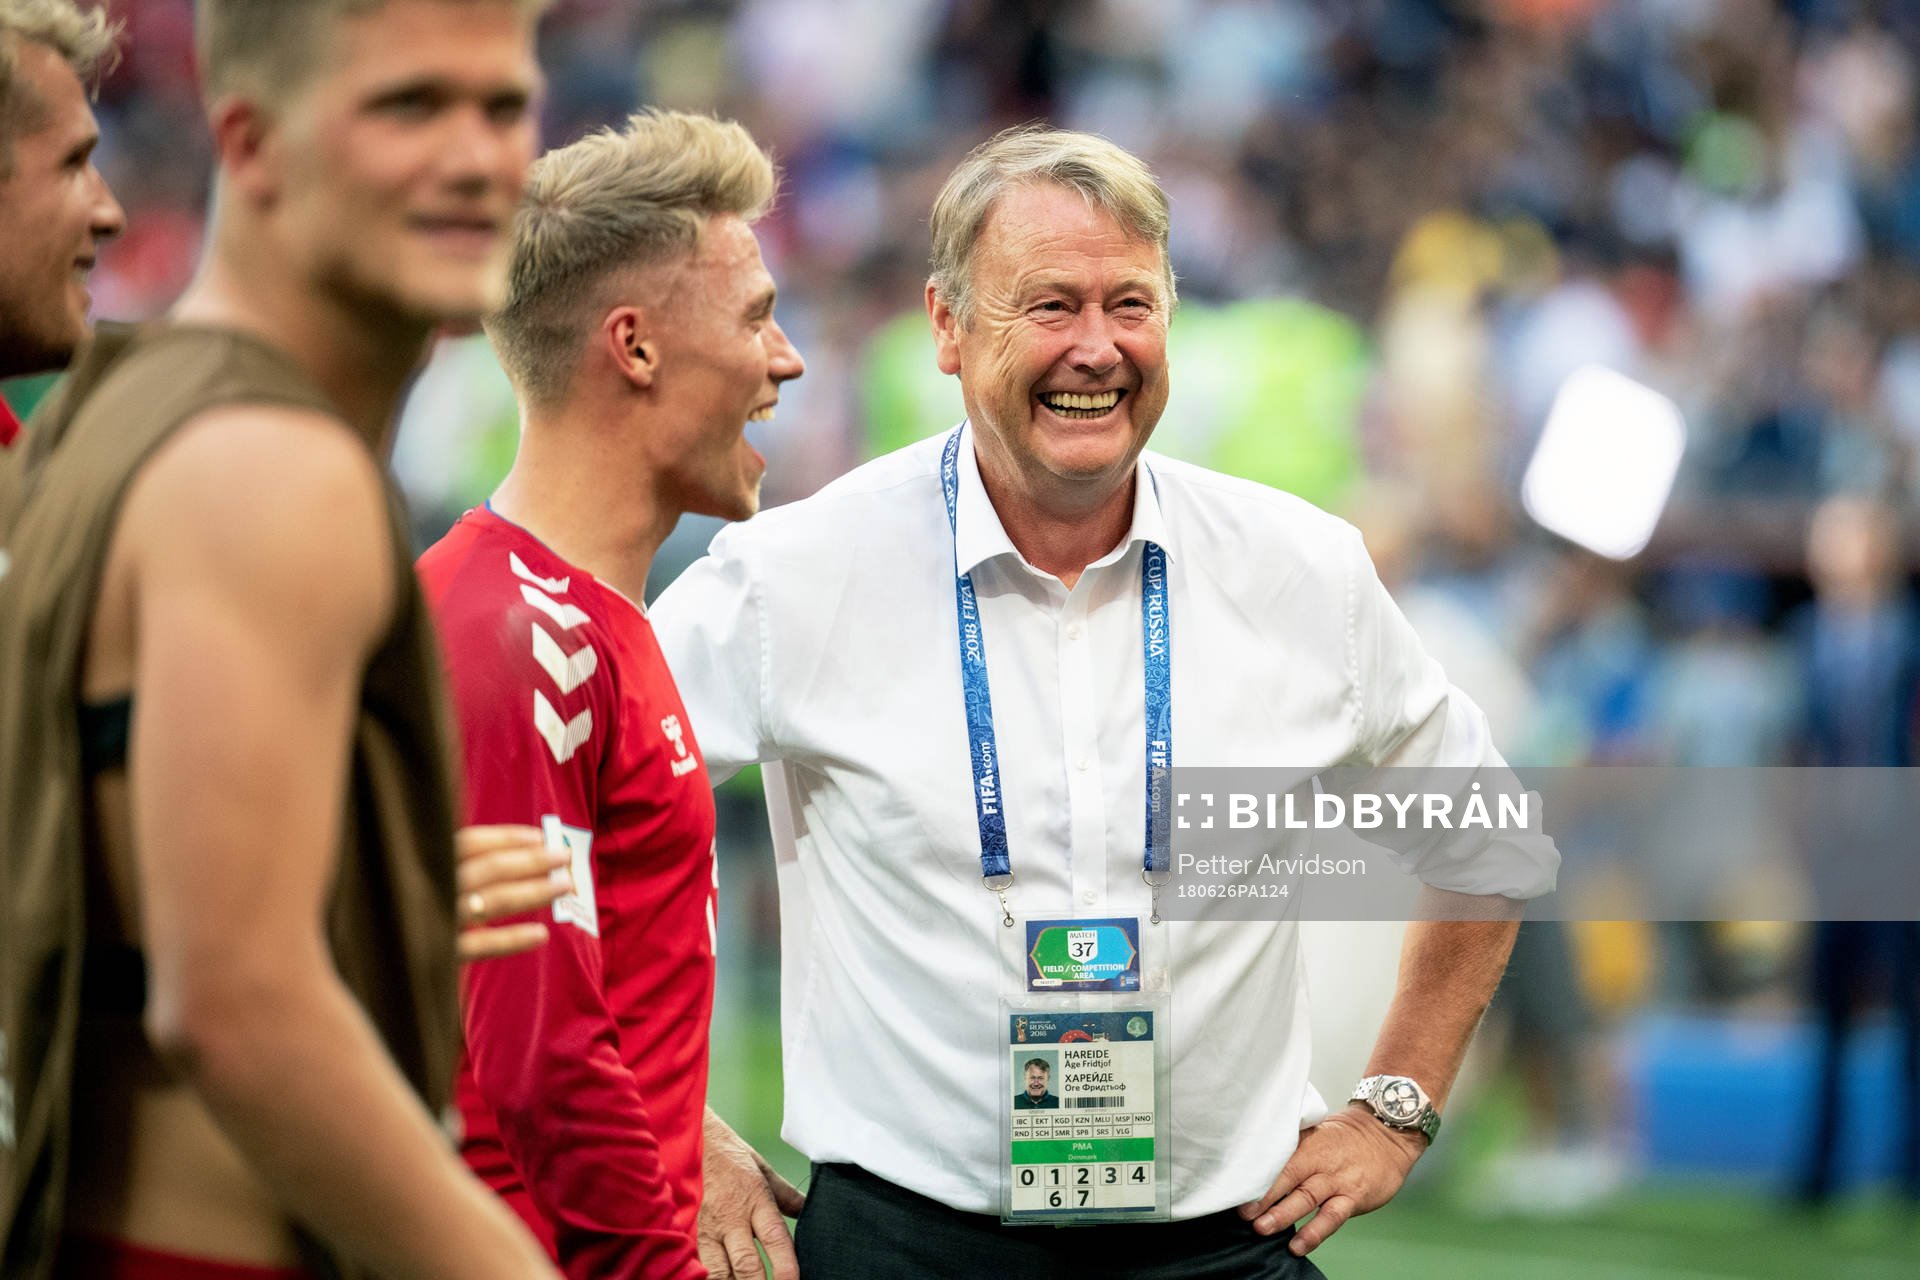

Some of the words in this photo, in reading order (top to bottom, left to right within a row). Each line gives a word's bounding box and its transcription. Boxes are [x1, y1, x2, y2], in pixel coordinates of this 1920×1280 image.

[1148, 555, 1162, 590] CUP
[961, 585, 977, 620] FIFA
[1148, 594, 1165, 658] RUSSIA
[964, 623, 980, 662] 2018
[1069, 931, 1096, 939] MATCH
[1071, 942, 1095, 958] 37
[1043, 965, 1064, 973] FIELD
[1071, 963, 1125, 972] COMPETITION
[1029, 1023, 1057, 1031] RUSSIA
[1064, 1050, 1109, 1059] HAREIDE
[1082, 1059, 1111, 1069] Fridtjof
[1065, 1072, 1114, 1083] ХАРЕЙДЕ
[1082, 1083, 1126, 1092] Фридтьоф
[1072, 1142, 1093, 1150] PMA
[1020, 1169, 1035, 1186] 0
[1050, 1168, 1060, 1185] 1
[1077, 1168, 1090, 1185] 2
[1105, 1167, 1117, 1184] 3
[1131, 1166, 1146, 1183] 4
[1049, 1190, 1062, 1207] 6
[1077, 1190, 1089, 1207] 7
